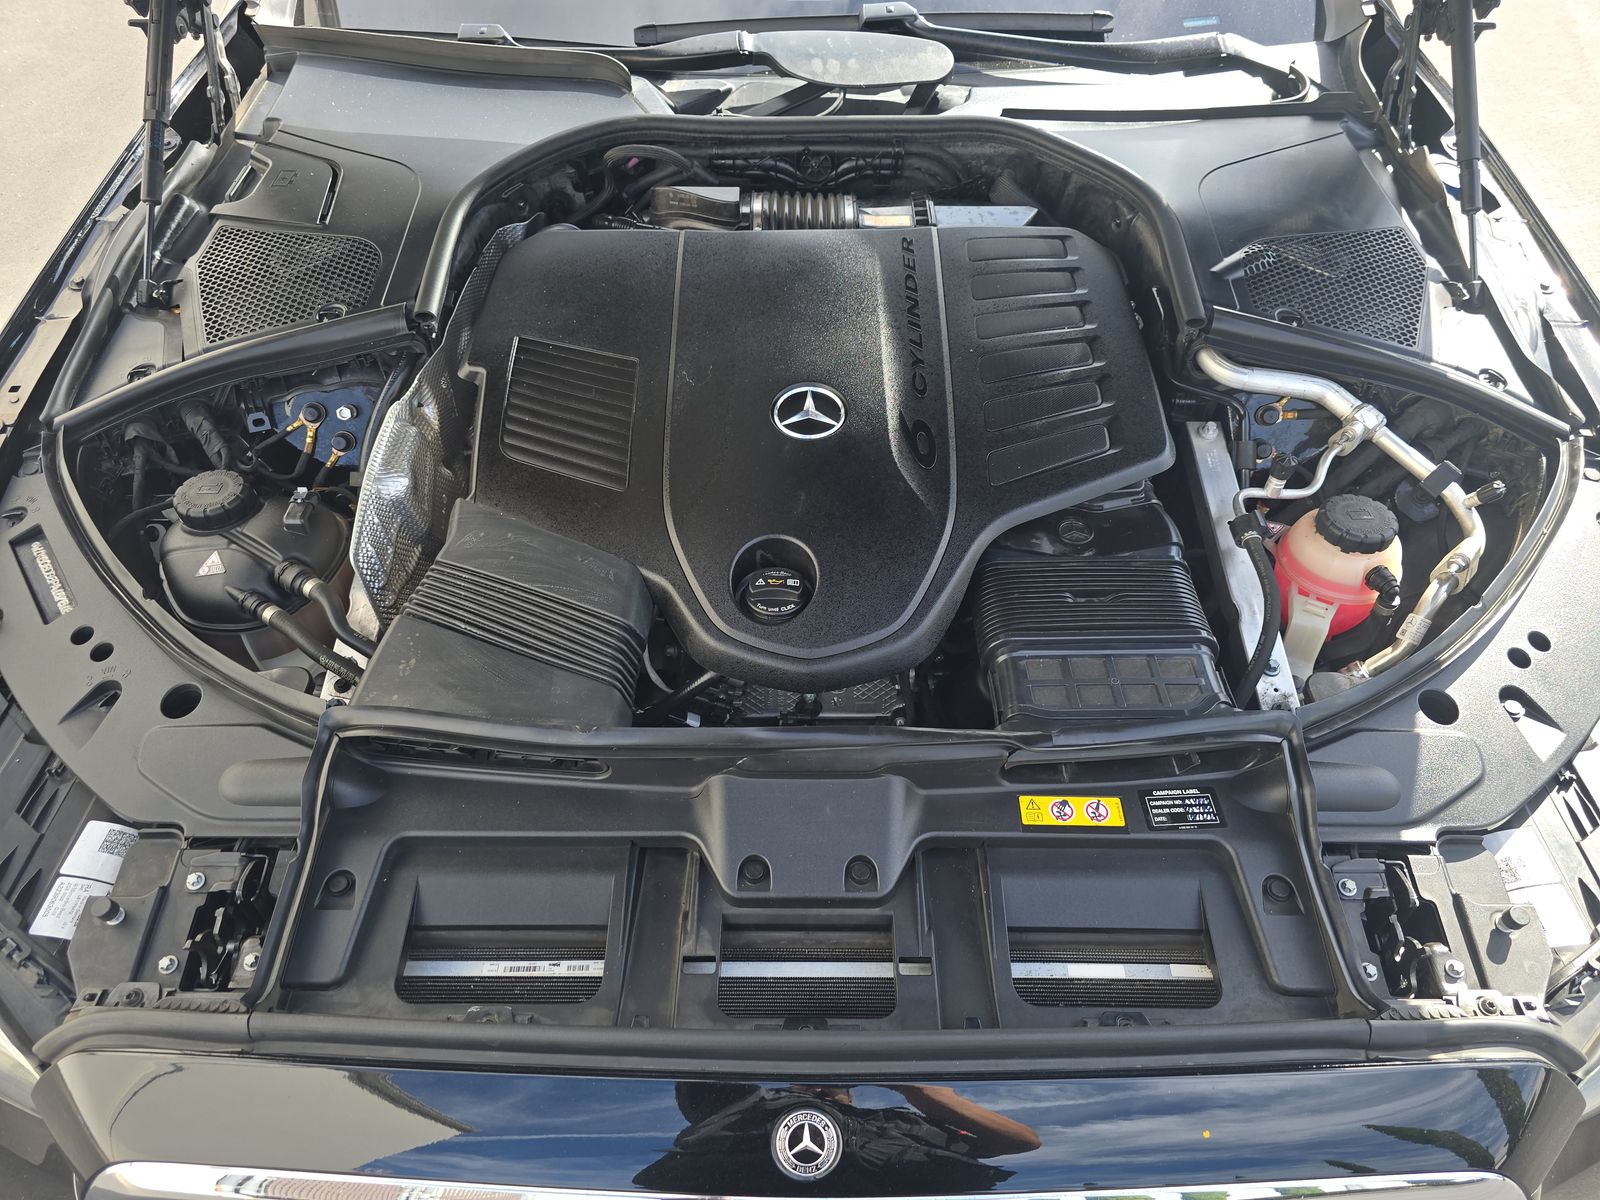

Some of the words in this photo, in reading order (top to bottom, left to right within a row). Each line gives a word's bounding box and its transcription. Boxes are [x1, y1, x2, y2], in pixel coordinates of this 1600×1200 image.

[902, 236, 928, 398] CYLINDER
[780, 604, 796, 612] CLICK
[787, 1113, 826, 1128] MERCEDES
